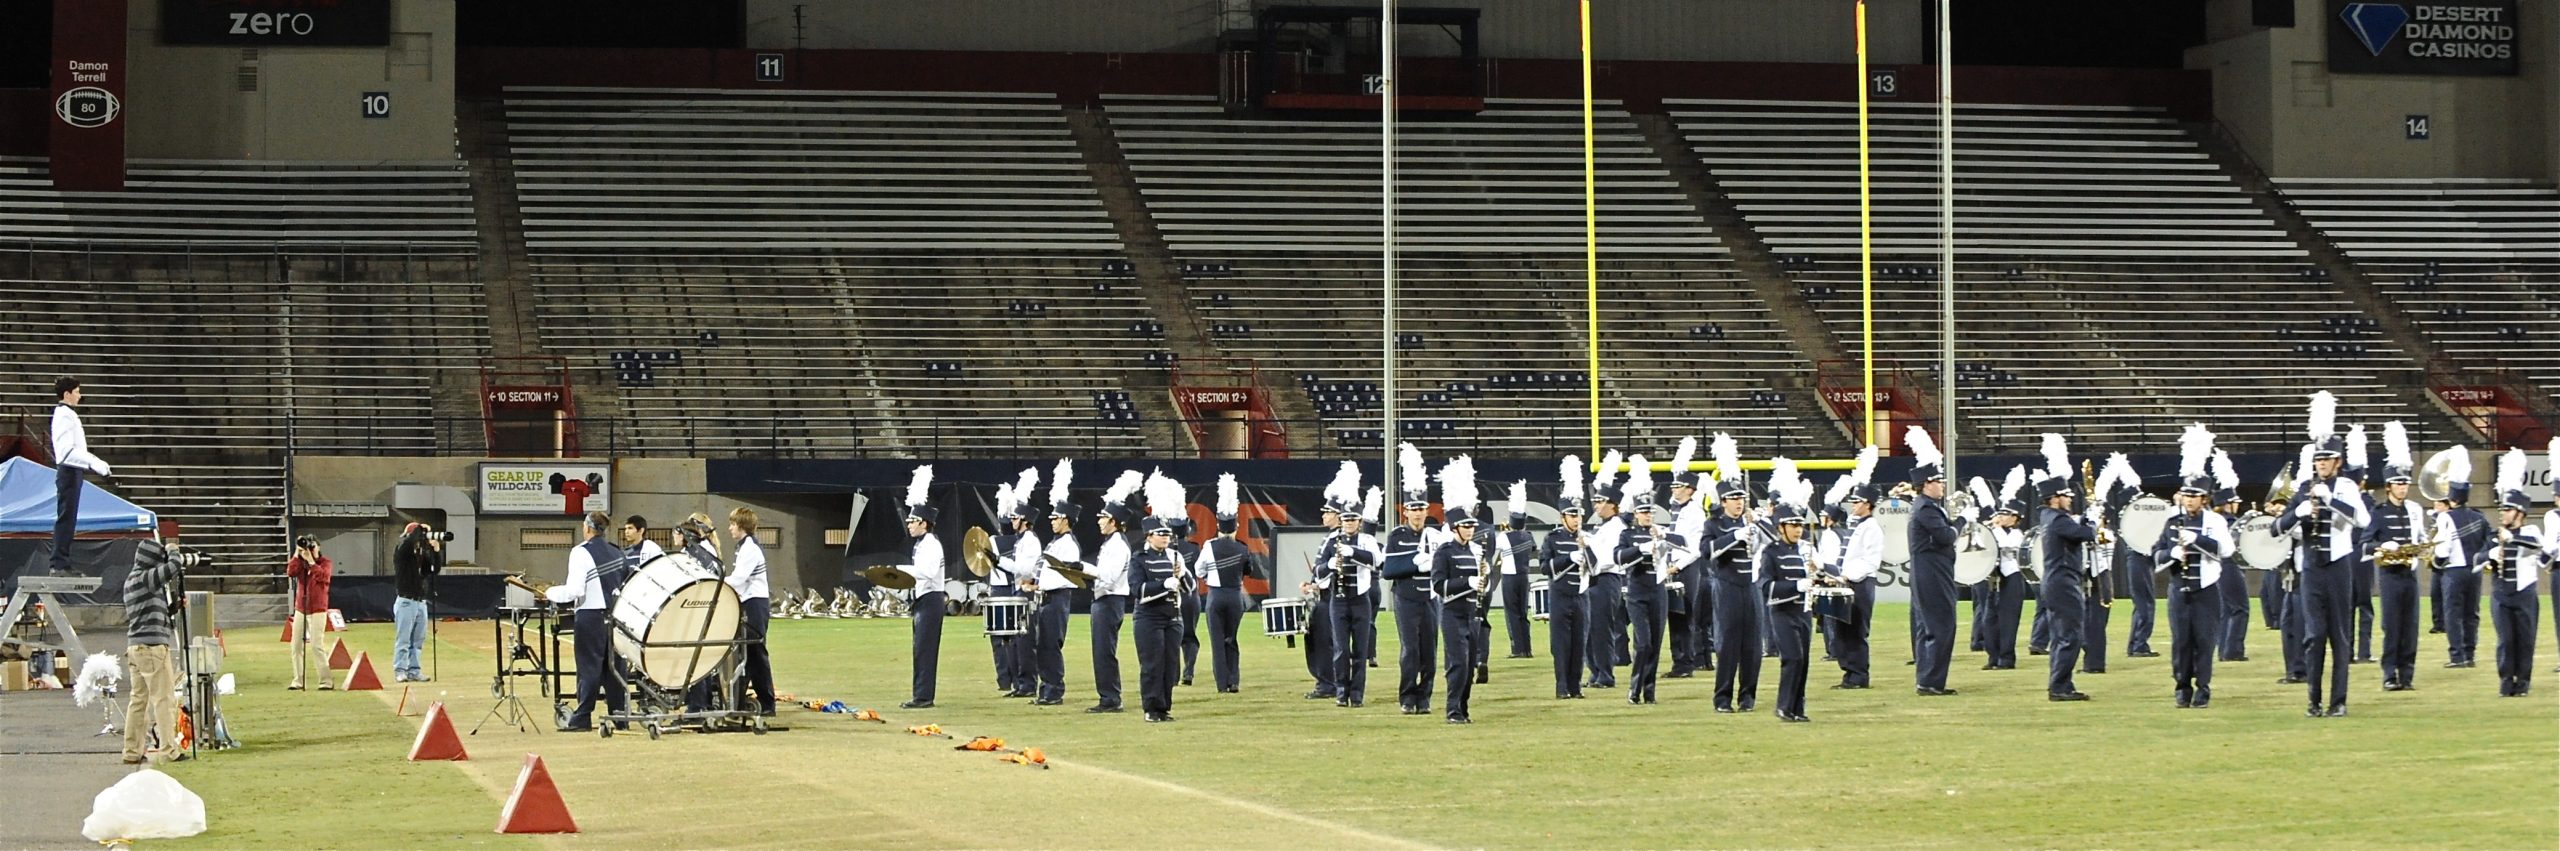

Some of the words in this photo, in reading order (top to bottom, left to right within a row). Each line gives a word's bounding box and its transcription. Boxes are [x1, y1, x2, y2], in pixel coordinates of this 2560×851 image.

[2415, 5, 2503, 22] DESERT
[229, 12, 314, 36] zero
[2405, 23, 2514, 41] DIAMOND
[2408, 42, 2512, 59] CASINOS
[69, 60, 109, 71] Damon
[761, 58, 779, 77] 11
[72, 71, 107, 82] Terrell
[1364, 76, 1384, 94] 12
[1873, 75, 1895, 93] 13
[81, 103, 96, 113] 80
[362, 95, 389, 115] 10
[2407, 118, 2428, 136] 14
[497, 391, 507, 402] 10
[508, 391, 541, 402] SECTION
[543, 391, 551, 402] 11
[1197, 392, 1229, 403] SECTION
[1231, 392, 1240, 403] 12
[487, 471, 521, 482] GEAR
[526, 471, 544, 482] UP
[488, 482, 543, 491] WILDCATS
[1885, 506, 1909, 515] YAMAHA
